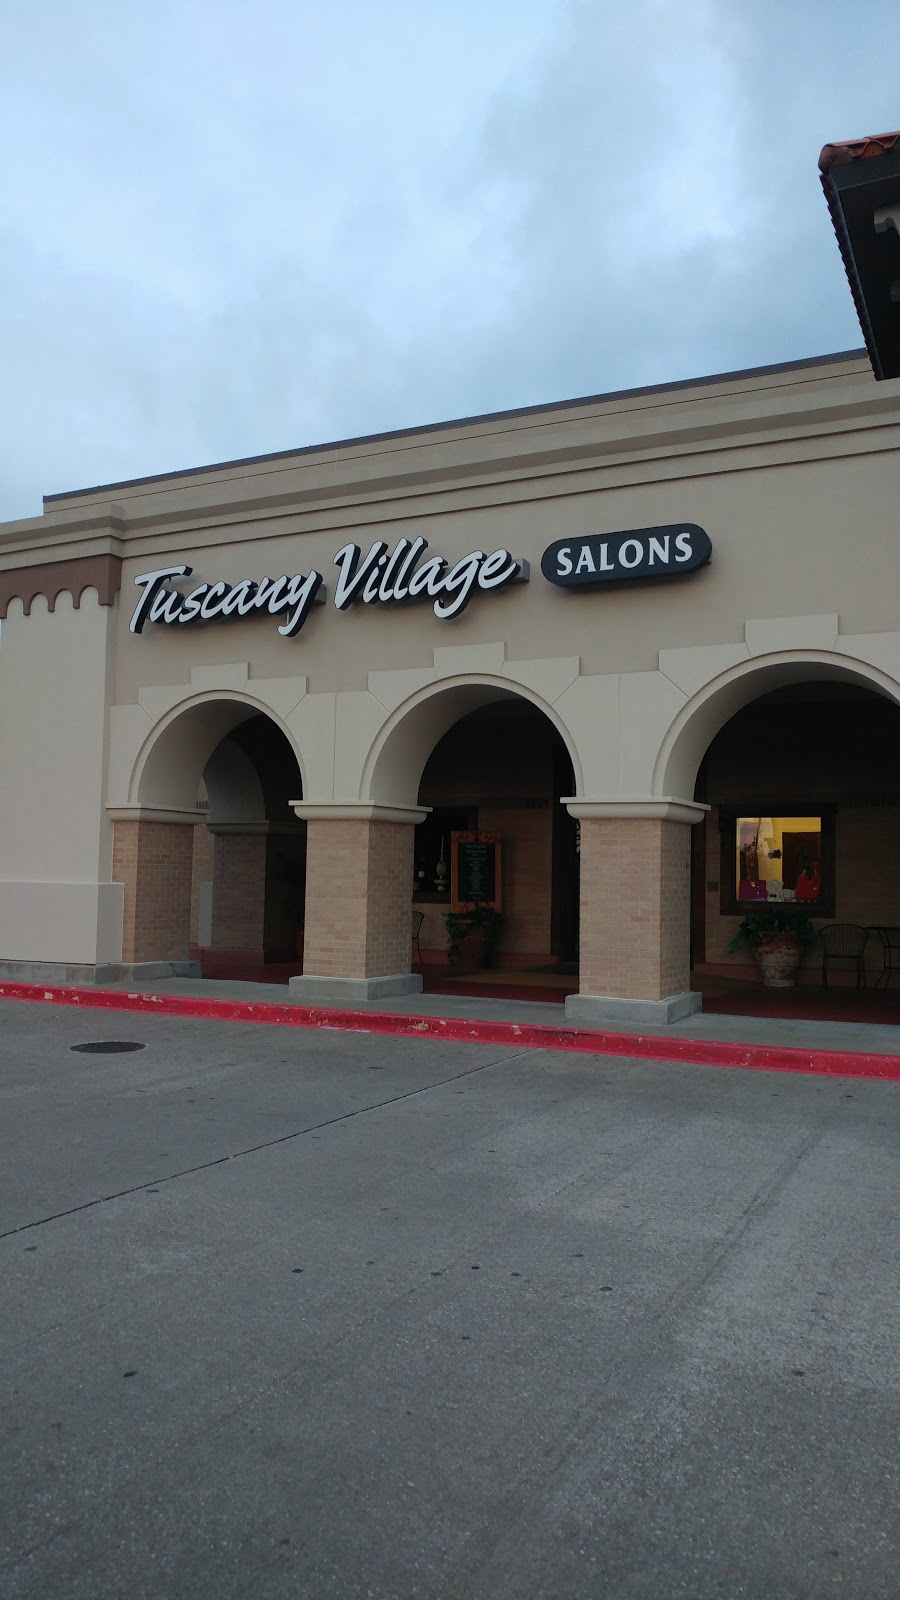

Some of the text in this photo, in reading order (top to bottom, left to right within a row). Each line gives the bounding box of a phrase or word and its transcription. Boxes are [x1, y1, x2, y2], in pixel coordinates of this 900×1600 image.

[129, 536, 519, 637] Tuscany Village
[556, 532, 693, 576] SALONS
